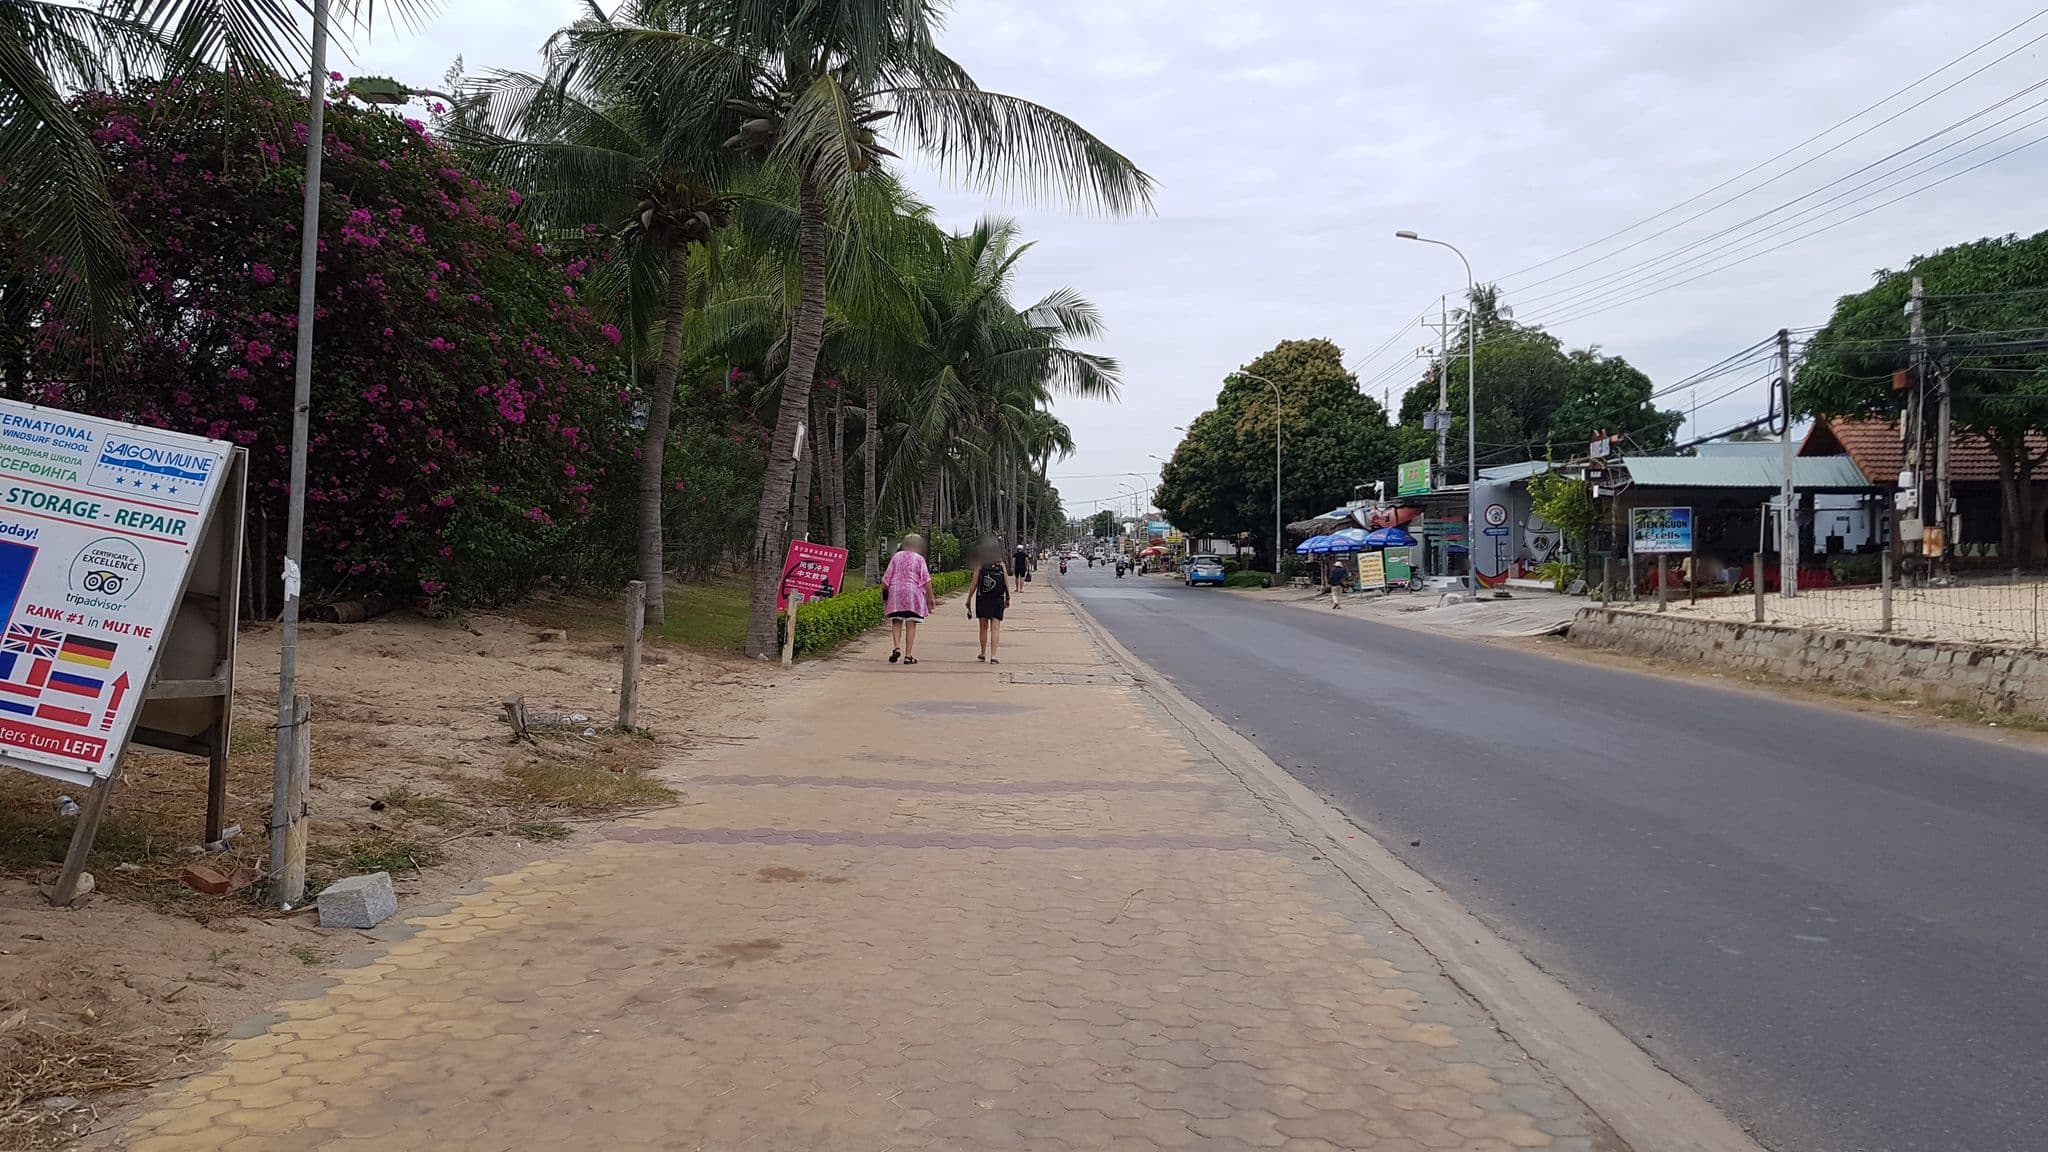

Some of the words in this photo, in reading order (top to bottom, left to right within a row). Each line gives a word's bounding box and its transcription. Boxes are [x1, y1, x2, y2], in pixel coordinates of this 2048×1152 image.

[0, 413, 93, 442] ERNATIONAL
[3, 429, 50, 444] WINDSURF
[52, 439, 89, 453] SCHOOL
[104, 441, 164, 462] SAIGON
[0, 456, 77, 482] СЕРФИНГА
[50, 454, 82, 466] ШКОЛА
[6, 487, 101, 520] STORAGE
[114, 508, 186, 536] REPAIR
[0, 521, 39, 541] oday!
[82, 554, 139, 572] EXCELLENCE
[92, 549, 129, 561] CERTIFICATE
[66, 593, 124, 611] tripadvisor
[25, 604, 62, 621] RANK
[66, 612, 84, 625] #1
[87, 616, 99, 628] in
[102, 619, 130, 634] MUI
[133, 626, 153, 639] NE
[29, 733, 60, 750] turn
[63, 739, 103, 758] LEFT
